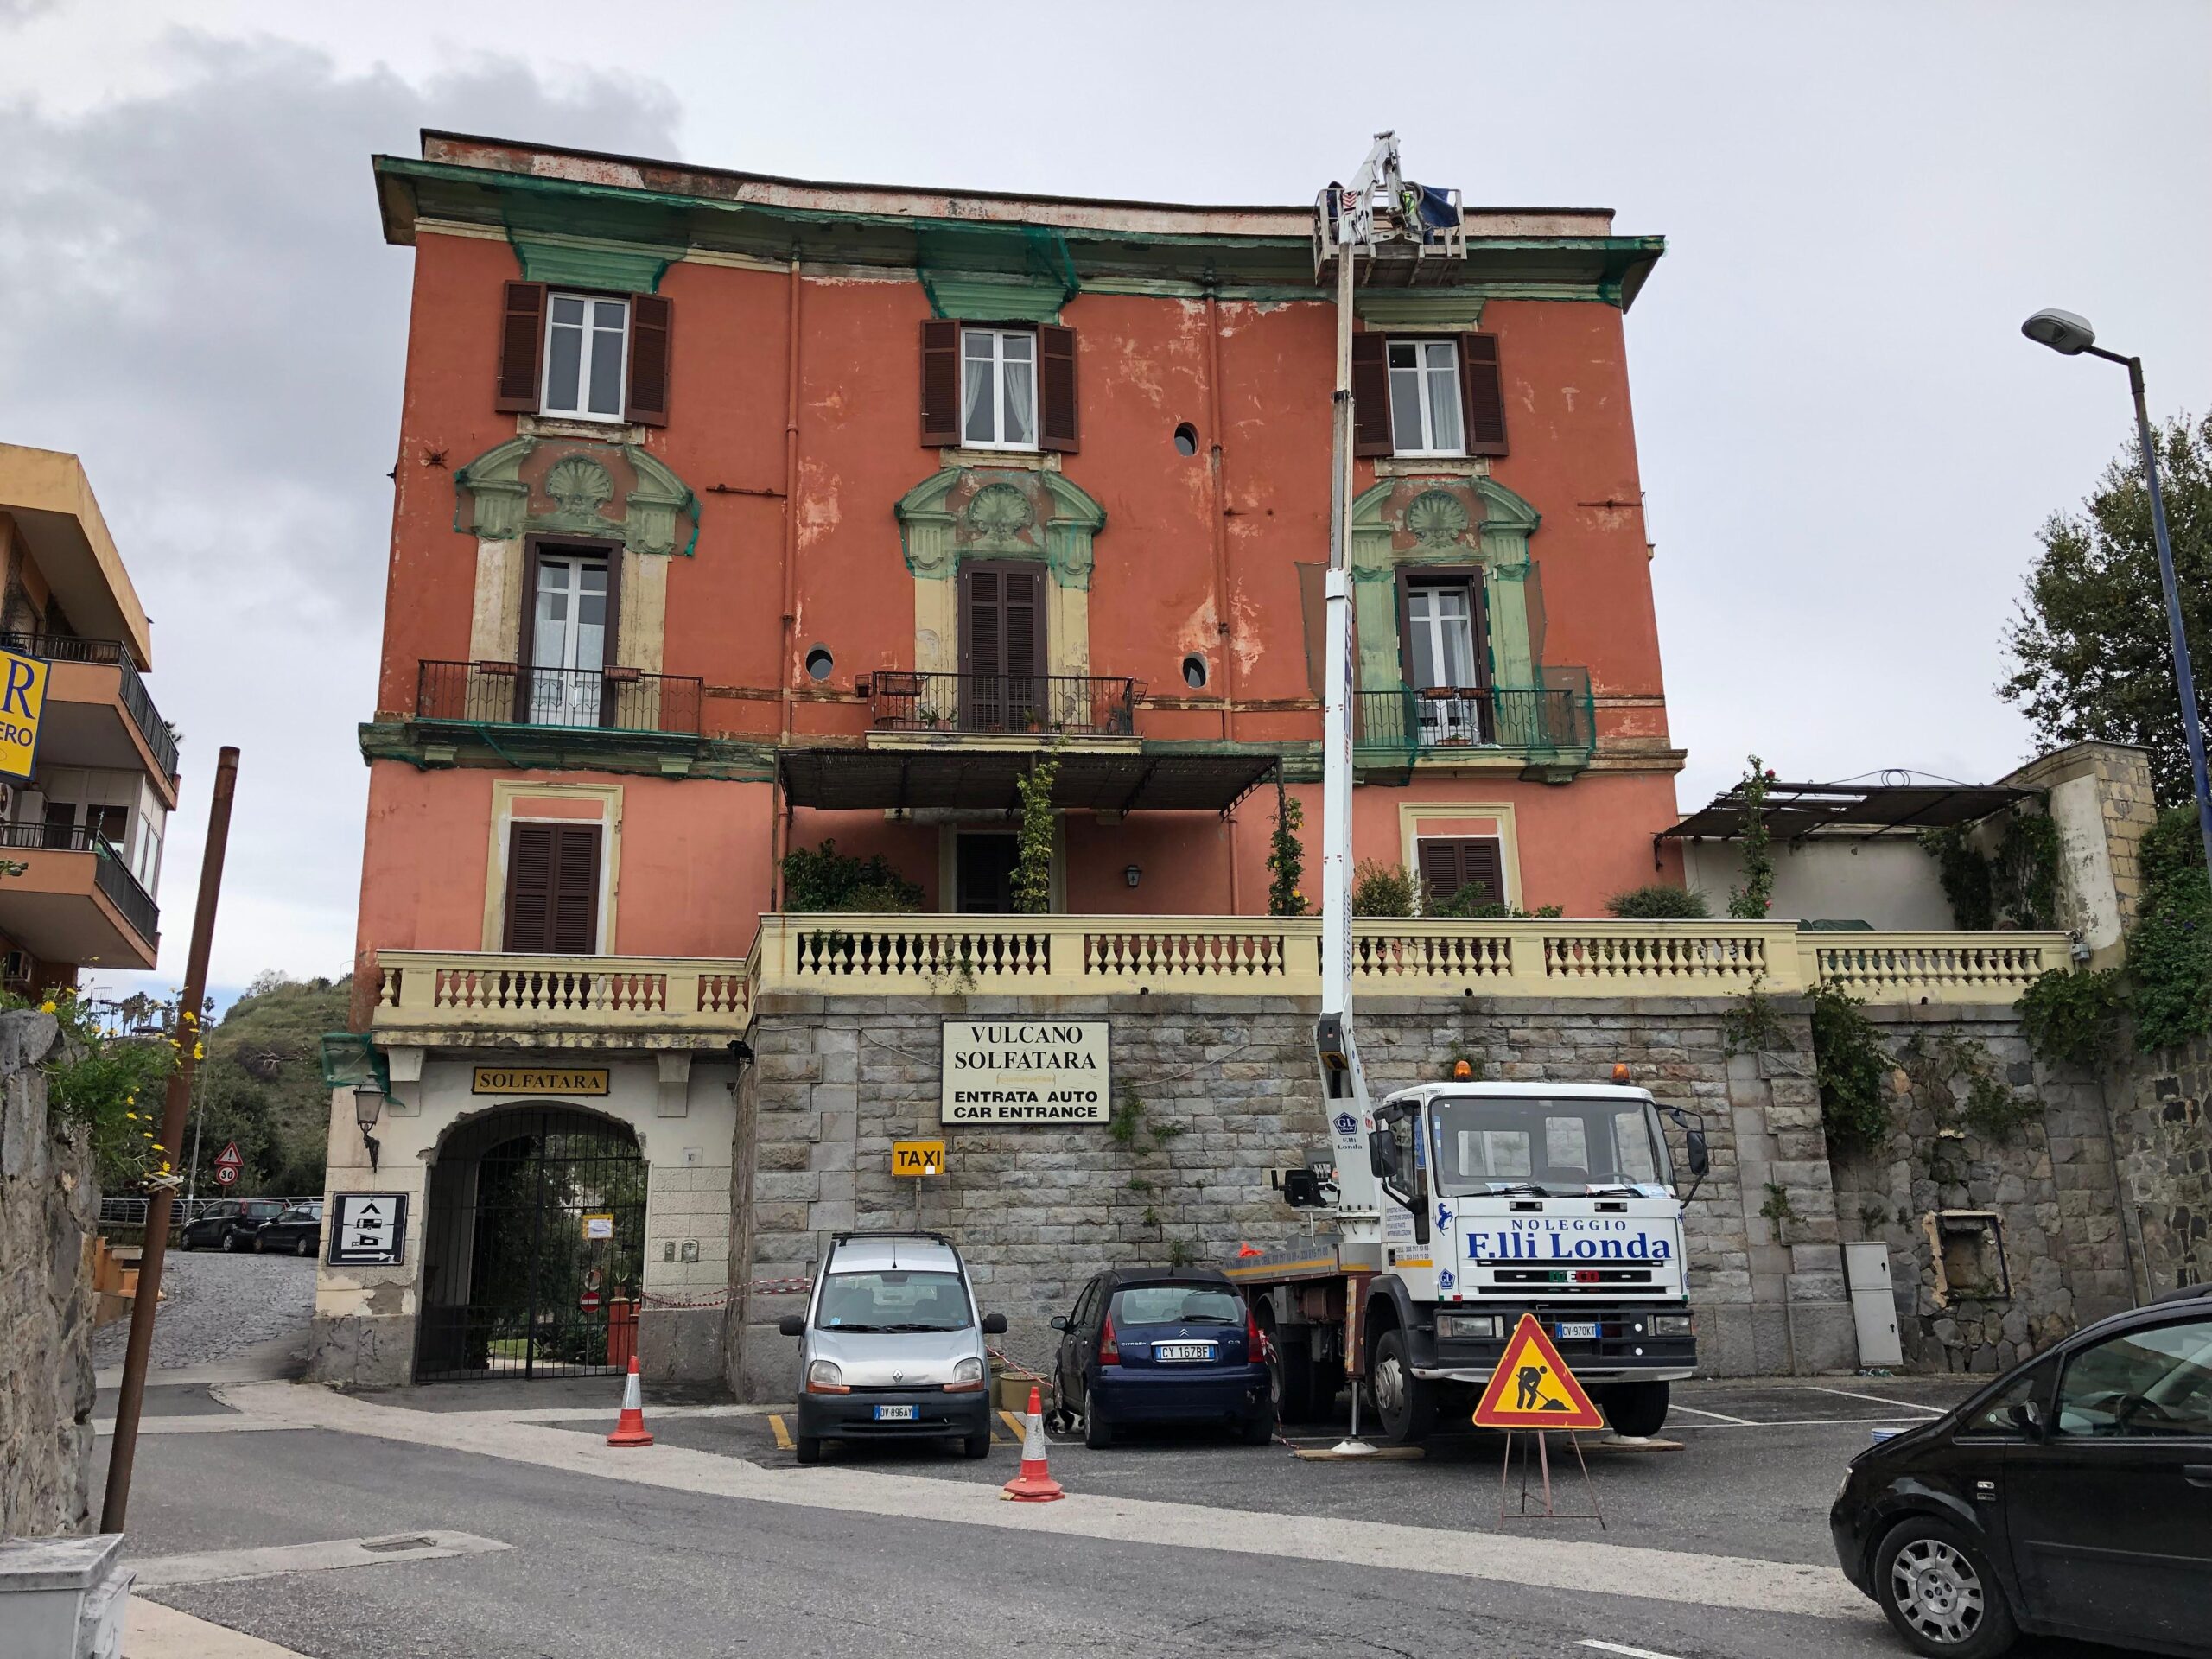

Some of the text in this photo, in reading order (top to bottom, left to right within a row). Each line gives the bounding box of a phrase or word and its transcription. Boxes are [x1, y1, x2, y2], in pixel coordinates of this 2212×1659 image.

[971, 1026, 1083, 1044] VULCANO
[954, 1051, 1097, 1070] SOLFATARA
[480, 1073, 601, 1089] SOLFATARA
[955, 1091, 1098, 1103] ENTRATA AUTO
[953, 1107, 1098, 1118] CAR ENTRANCE
[1337, 1118, 1355, 1128] GL
[897, 1150, 941, 1166] TAXI
[220, 1170, 234, 1179] 30
[1511, 1219, 1626, 1230] NOLEGGIO
[1466, 1232, 1672, 1259] F.lli Londa
[1548, 1270, 1600, 1283] IVECO
[1162, 1346, 1208, 1358] CY 167BF
